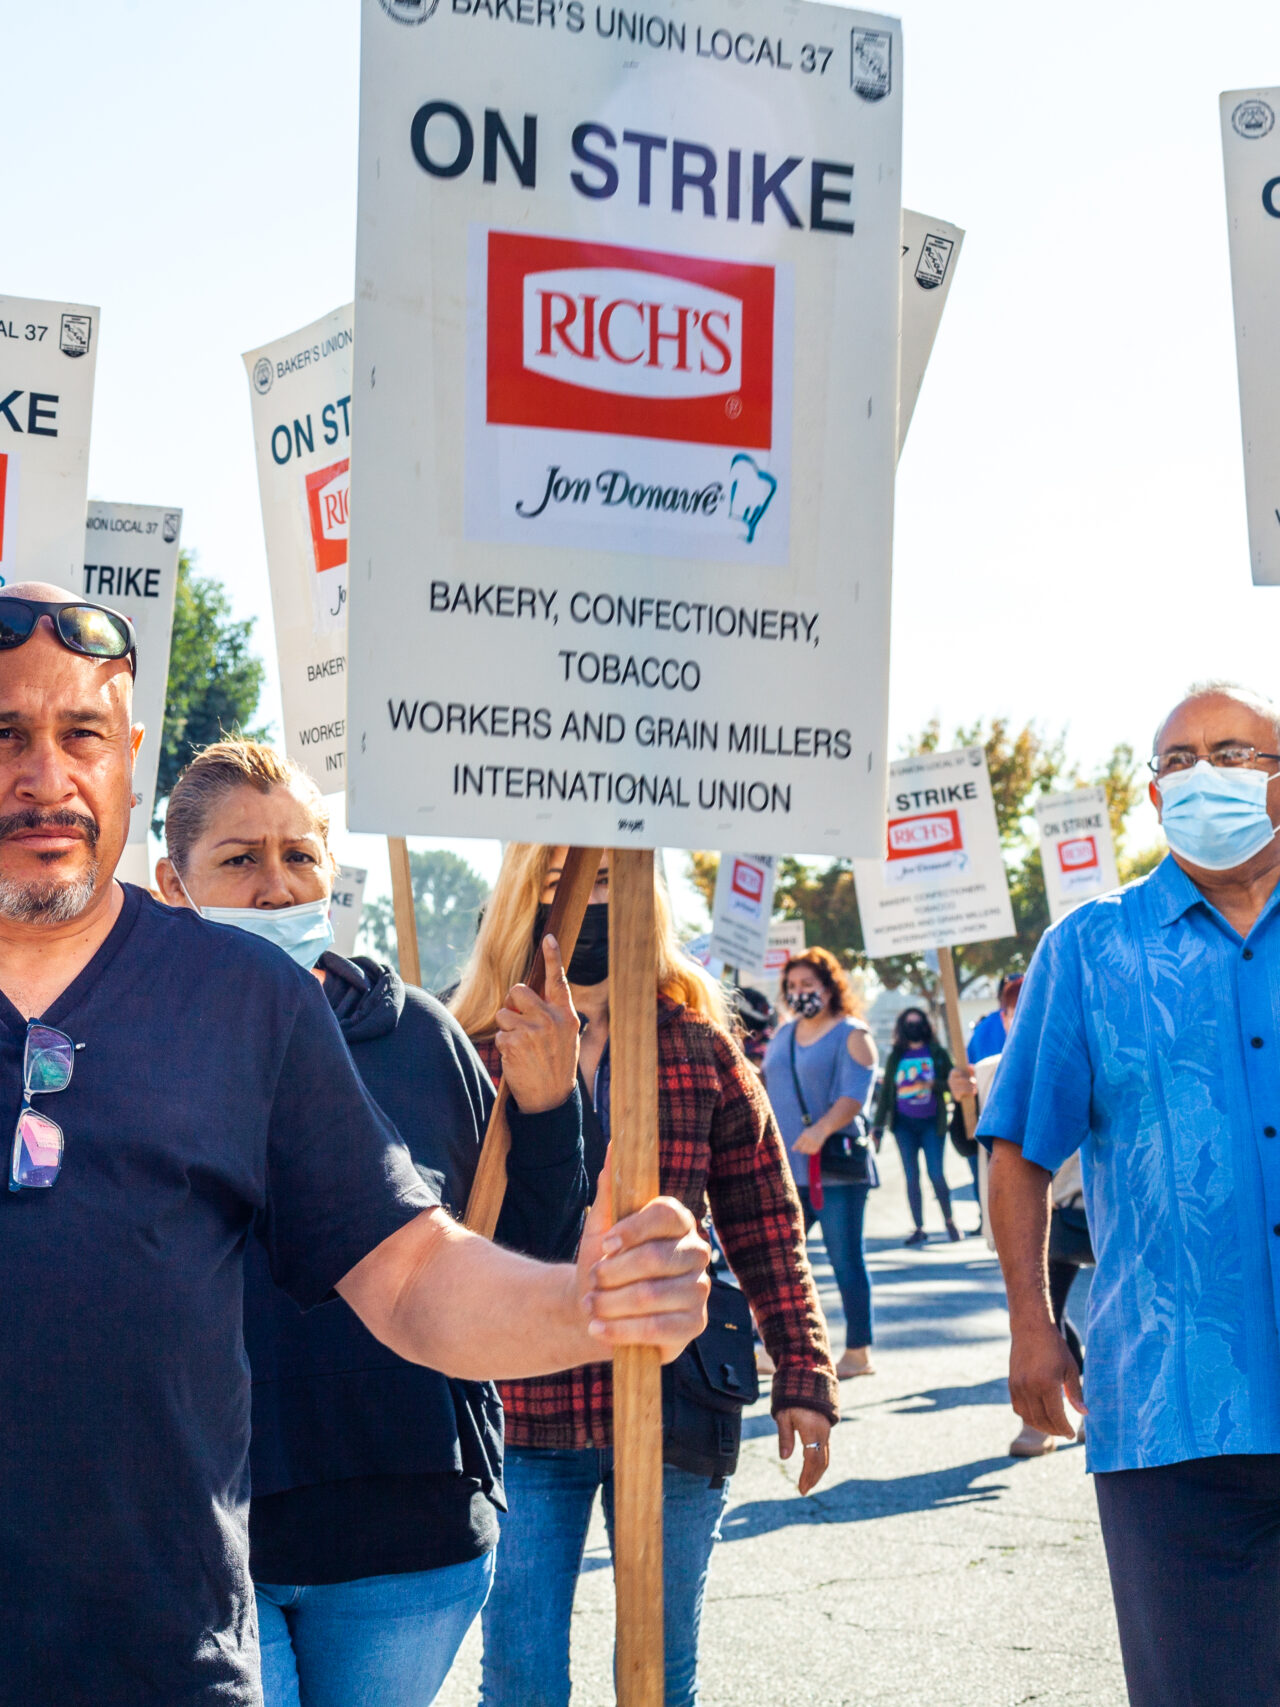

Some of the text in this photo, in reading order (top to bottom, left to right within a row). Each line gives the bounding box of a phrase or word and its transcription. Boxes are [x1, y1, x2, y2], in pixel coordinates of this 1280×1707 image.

[595, 7, 687, 53] UNION
[695, 28, 793, 70] LOCAL
[799, 44, 835, 75] 37
[410, 99, 855, 236] ON STRIKE
[24, 324, 49, 342] 37
[276, 329, 352, 378] BAKER'S UNION
[534, 288, 732, 376] RICH'S
[271, 414, 315, 465] ON
[515, 465, 591, 519] Jon
[86, 517, 159, 534] NION LOCAL 37
[84, 564, 161, 598] TRIKE
[428, 579, 821, 649] BAKERY, CONFECTIONERY,
[558, 650, 702, 693] TOBACCO
[388, 699, 852, 761] WORKERS AND GRAIN MILLERS
[453, 763, 792, 815] INTERNATIONAL UNION
[896, 782, 977, 811] STRIKE
